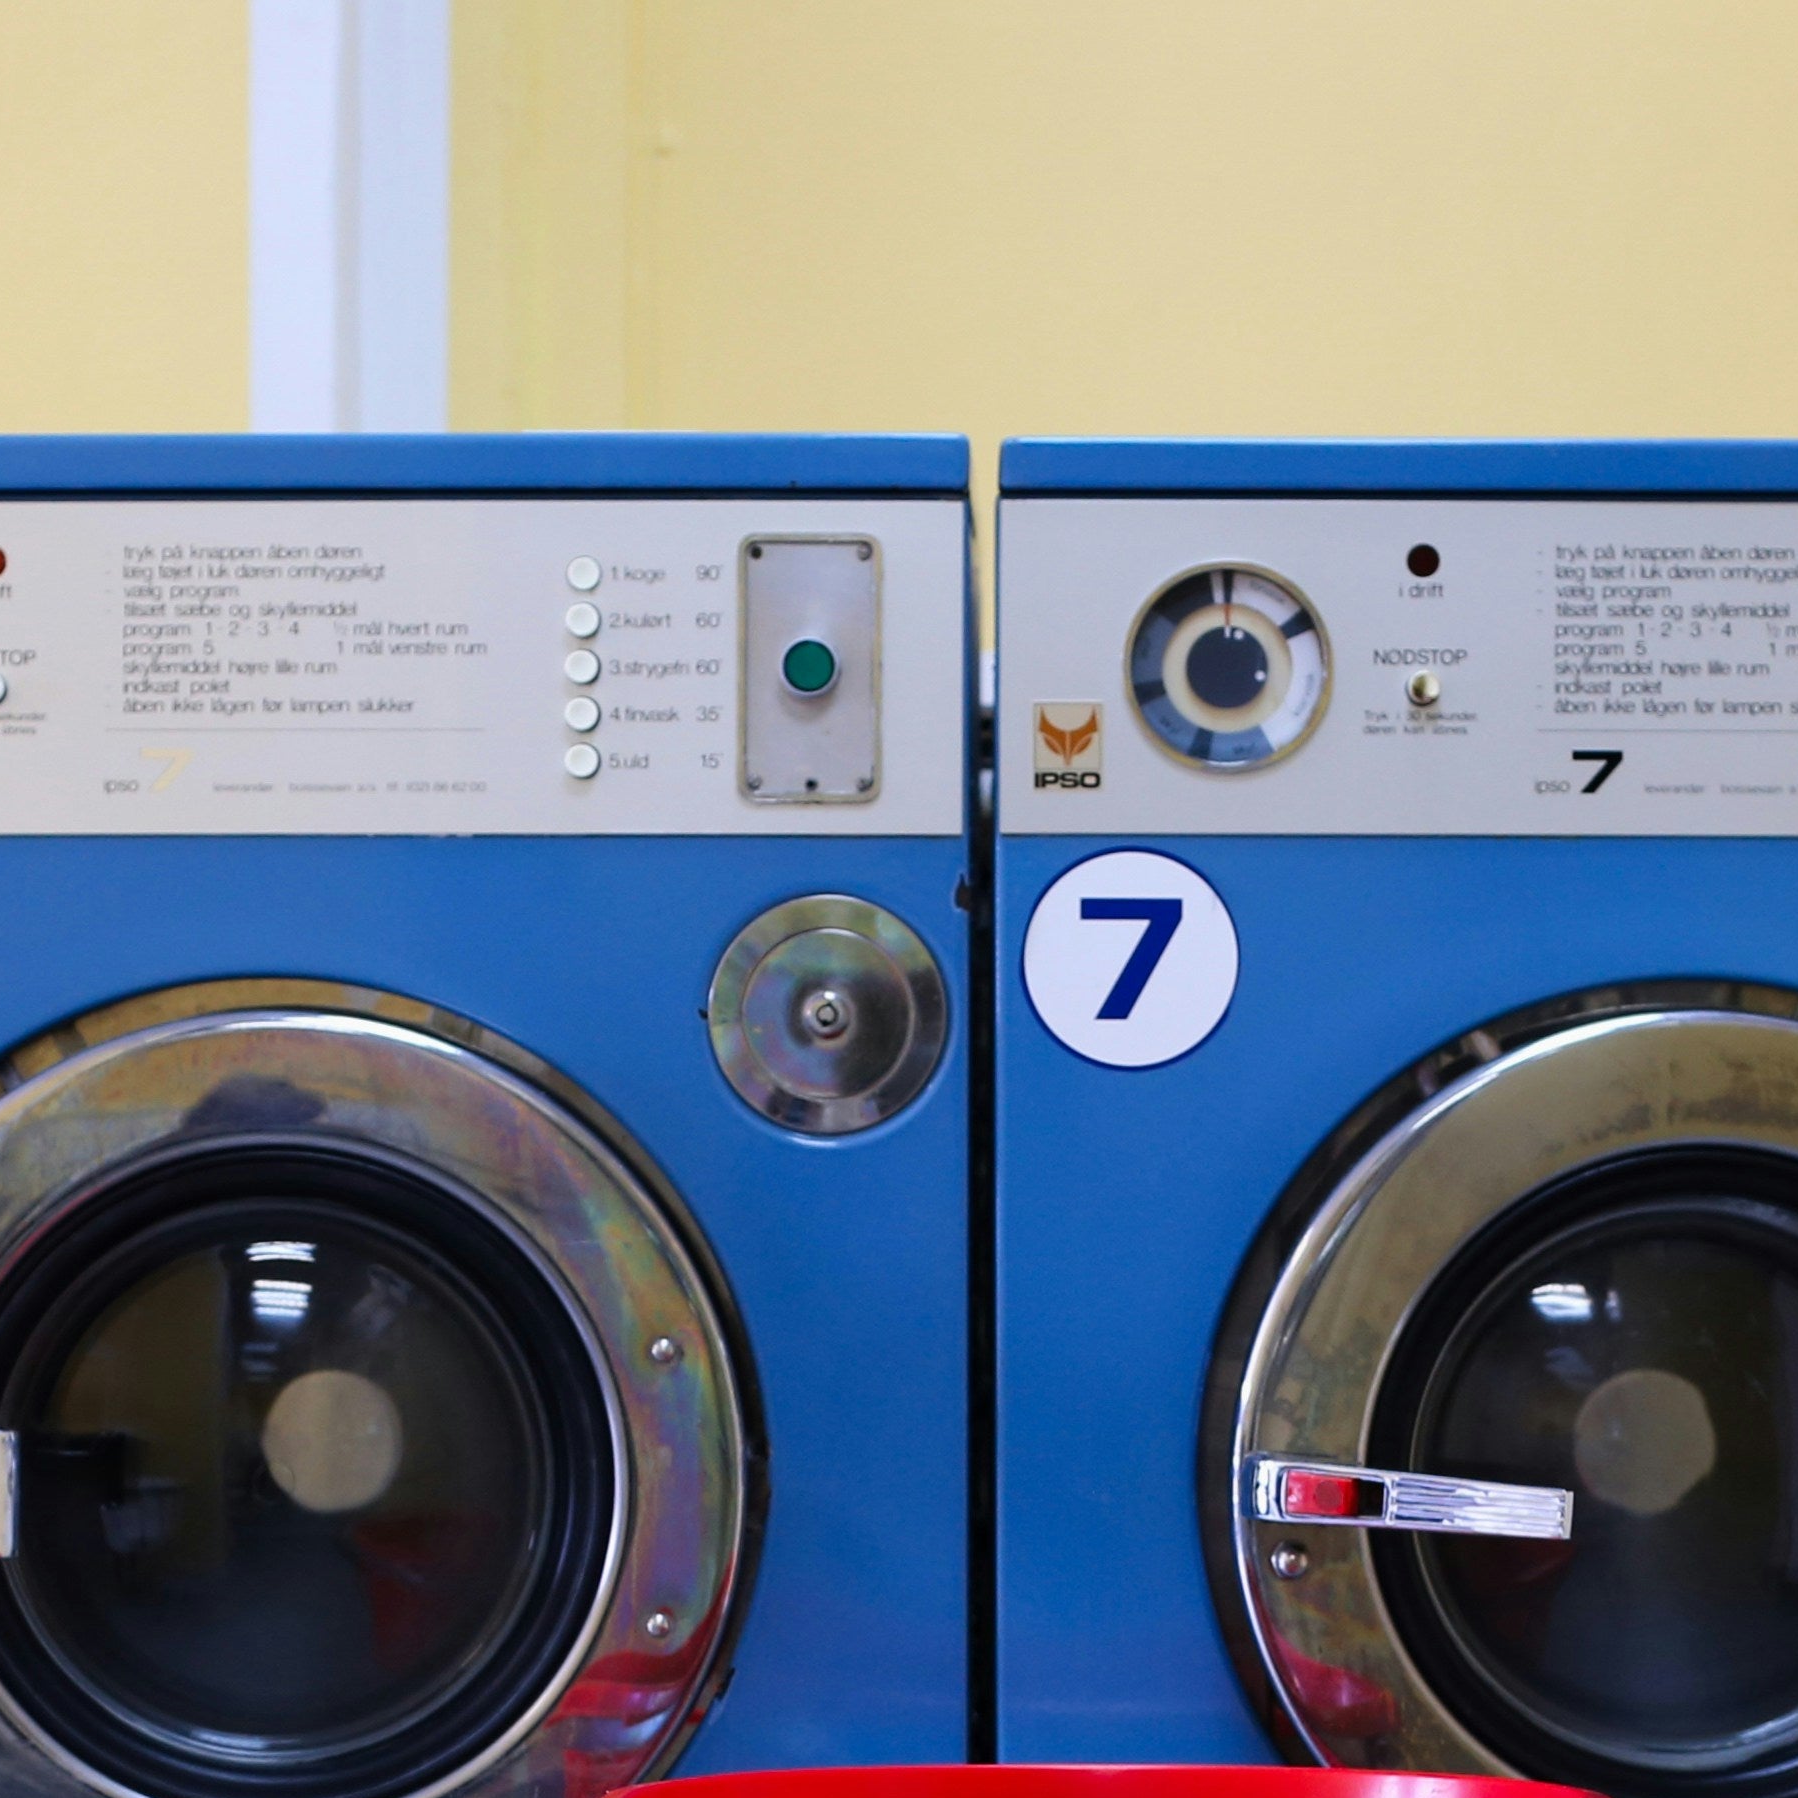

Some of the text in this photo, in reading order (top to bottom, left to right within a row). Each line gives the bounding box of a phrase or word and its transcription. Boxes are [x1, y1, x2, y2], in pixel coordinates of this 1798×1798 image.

[123, 545, 363, 563] tryk på knappen åben døren
[1555, 545, 1795, 563] tryk på knappen åben døren
[207, 564, 227, 578] luk
[234, 564, 283, 578] døren
[287, 564, 385, 582] omhyggeligt
[1639, 565, 1662, 579] luk
[1667, 565, 1715, 579] døren
[170, 585, 240, 601] program
[1410, 582, 1444, 598] drift
[1602, 586, 1672, 602] program
[229, 604, 250, 620] og
[1661, 605, 1683, 621] og
[1690, 603, 1790, 621] skyllemiddel
[122, 623, 191, 639] program
[206, 621, 212, 635] 1
[228, 621, 239, 635] 2
[257, 621, 269, 635] 3
[289, 621, 300, 635] 4
[353, 621, 382, 635] mål
[388, 621, 430, 635] hvert
[435, 623, 469, 635] rum
[1555, 624, 1624, 640] program
[1638, 621, 1644, 636] 1
[1660, 621, 1672, 636] 2
[1690, 621, 1702, 636] 3
[1721, 621, 1732, 636] 4
[122, 643, 192, 658] program
[203, 640, 214, 655] 5
[338, 640, 343, 655] 1
[388, 640, 448, 655] venstre
[454, 643, 487, 655] rum
[1555, 644, 1624, 659] program
[1635, 641, 1647, 656] 5
[1770, 641, 1776, 656] 1
[304, 662, 337, 674] rum
[1736, 663, 1770, 675] rum
[1555, 680, 1611, 694] indkast
[122, 698, 164, 712] åben
[290, 698, 351, 716] lampen
[358, 698, 415, 712] slukker
[1555, 699, 1597, 713] åben
[1722, 699, 1783, 717] lampen
[1034, 773, 1100, 789] IPSO
[1534, 780, 1571, 795] ipso
[1572, 750, 1623, 794] 7
[1080, 898, 1182, 1020] 7
